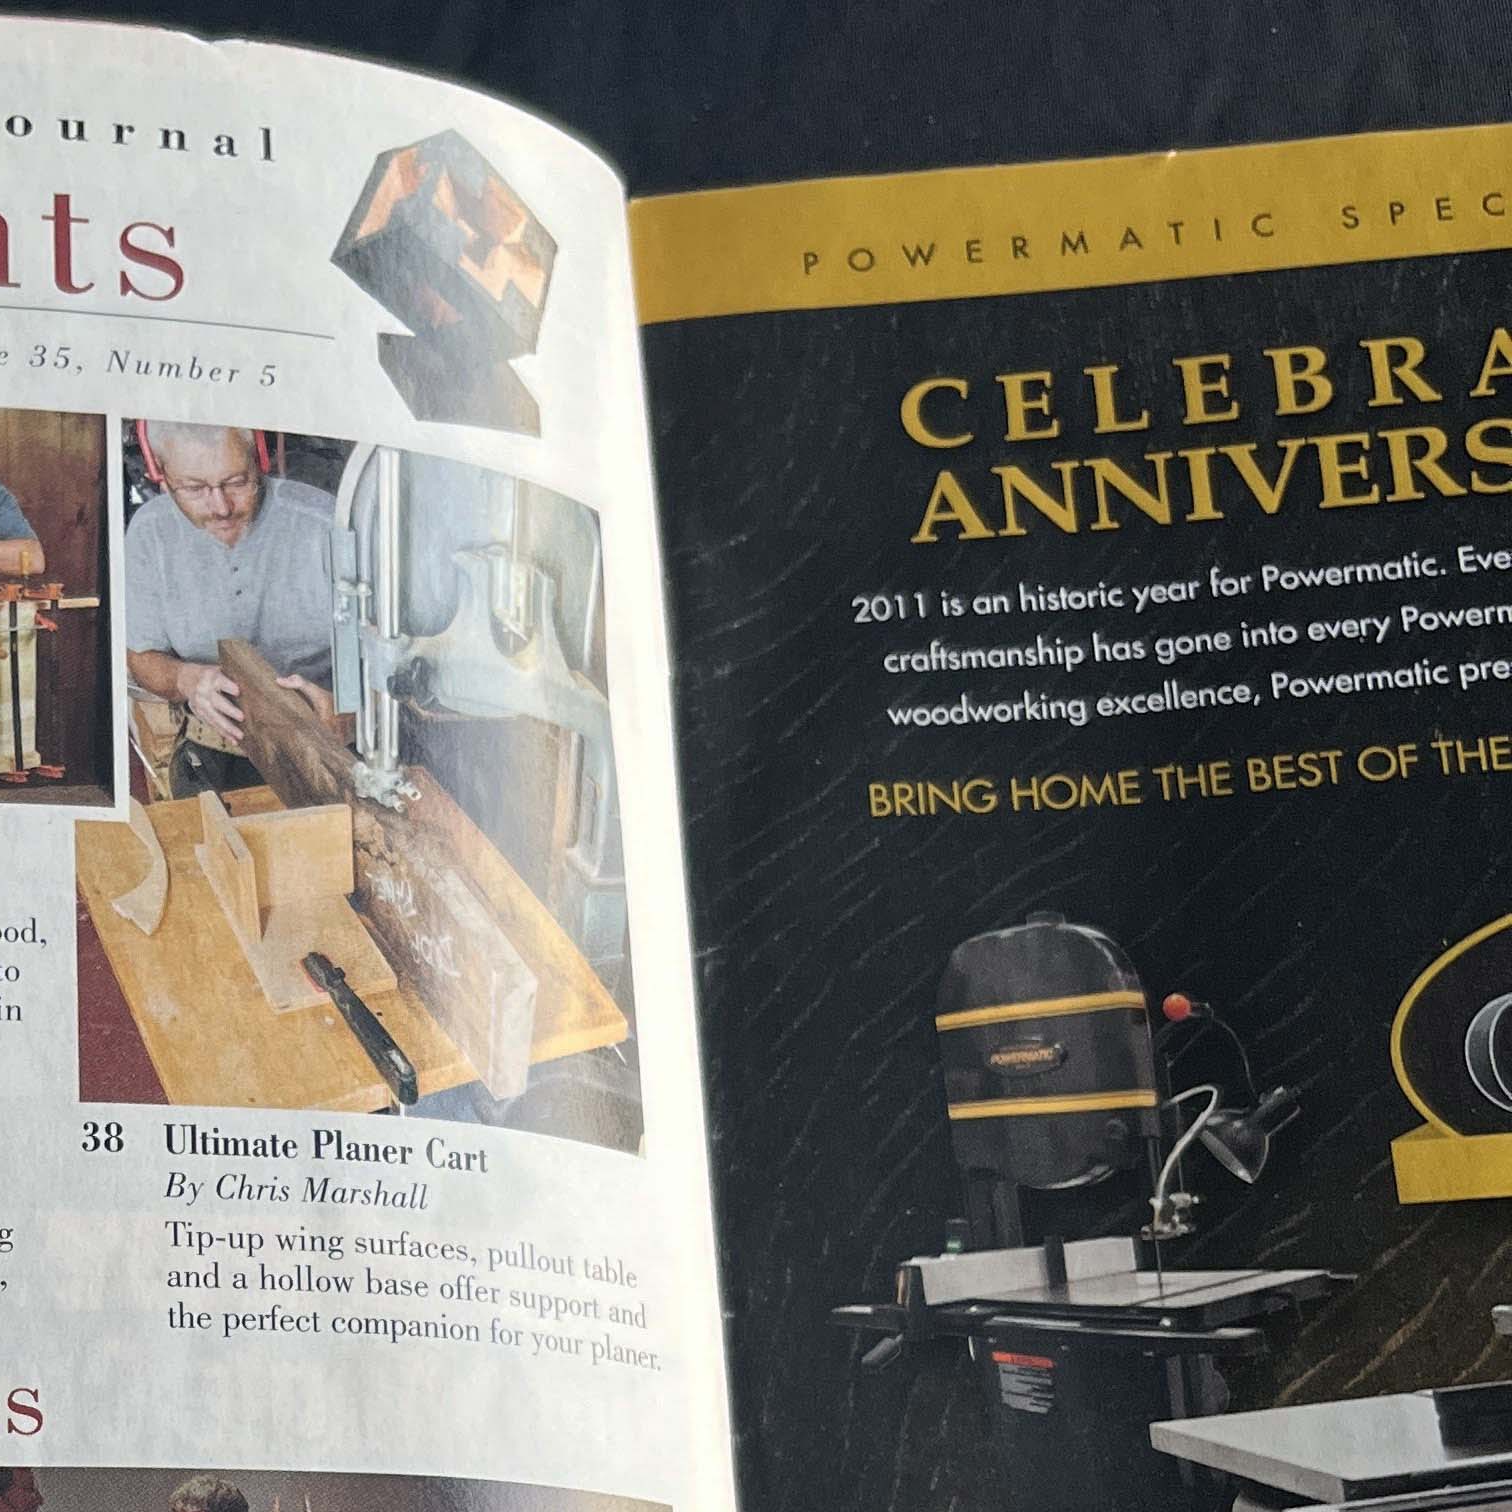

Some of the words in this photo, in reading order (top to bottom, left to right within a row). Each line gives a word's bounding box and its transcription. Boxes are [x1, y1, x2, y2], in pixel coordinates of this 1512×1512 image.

[803, 210, 1275, 276] POWERMATIC
[1341, 191, 1506, 230] SPEC
[28, 344, 83, 375] 35,
[106, 349, 240, 384] Number
[259, 364, 277, 387] 5
[910, 418, 1512, 545] ANNIVERS
[851, 591, 926, 624] 2011
[940, 589, 965, 617] is
[972, 594, 1011, 615] an
[1018, 581, 1125, 613] historic
[1131, 580, 1201, 614] year
[1209, 565, 1253, 598] for
[1261, 551, 1447, 592] Powermatic.
[1457, 544, 1512, 574] Eve
[868, 778, 999, 818] BRING
[1010, 769, 1142, 812] HOME
[1151, 760, 1234, 802] THE
[1246, 749, 1343, 793] BEST
[1357, 743, 1419, 782] OF
[1430, 733, 1512, 775] THE
[81, 1121, 125, 1153] 38
[163, 1123, 299, 1159] Ultimate
[311, 1129, 413, 1165] Planer
[425, 1136, 489, 1174] Cart
[164, 1220, 264, 1258] Tip-up
[274, 1227, 346, 1261] wing
[354, 1230, 477, 1266] surfaces,
[487, 1241, 576, 1277] pullout
[583, 1255, 638, 1289] table
[167, 1301, 212, 1330] the
[222, 1304, 321, 1338] perfect
[331, 1313, 480, 1344] companion
[489, 1317, 525, 1347] for
[530, 1331, 584, 1357] your
[590, 1332, 662, 1372] planer.
